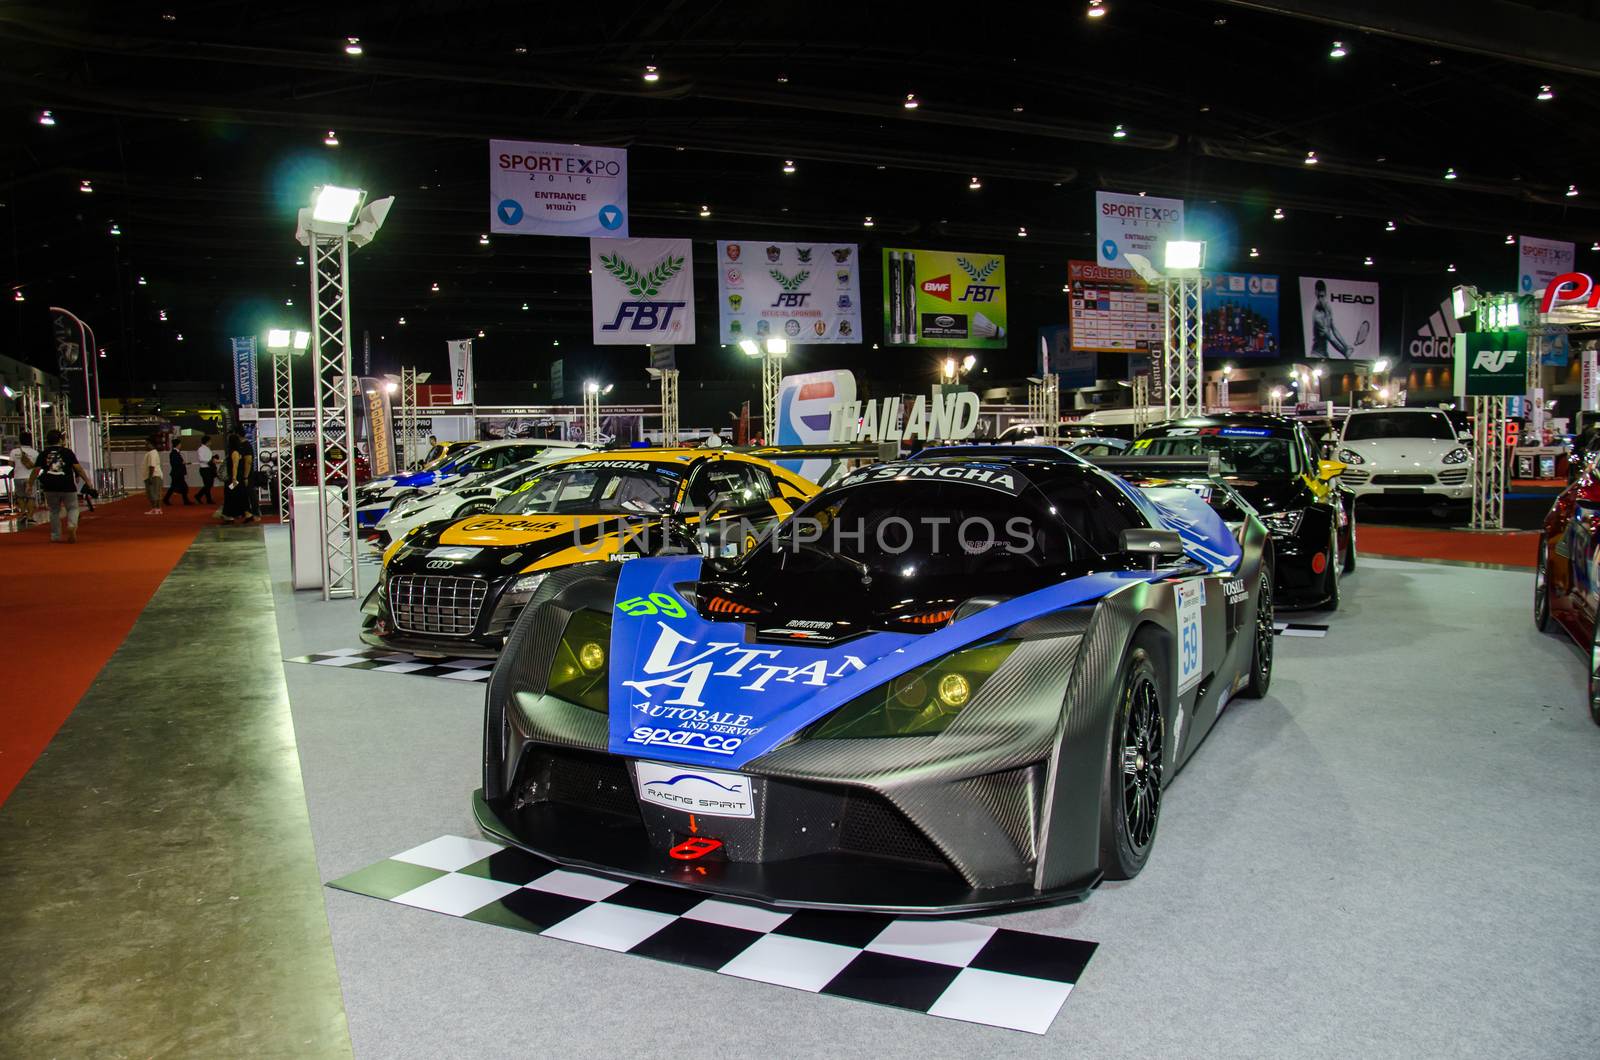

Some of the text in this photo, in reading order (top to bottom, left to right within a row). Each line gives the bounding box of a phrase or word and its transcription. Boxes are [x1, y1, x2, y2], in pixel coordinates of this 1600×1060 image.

[499, 154, 620, 176] SPORT EXPO
[534, 191, 587, 201] ENTRANCE
[1102, 203, 1142, 218] SPORT
[924, 282, 949, 293] BWF
[958, 285, 1000, 302] FBT
[1330, 292, 1375, 304] HEAD
[771, 292, 811, 307] FBT
[601, 301, 686, 330] FBT
[1472, 350, 1518, 372] RUF
[1151, 350, 1163, 399] Dynasty
[828, 391, 980, 442] THAILAND
[1224, 428, 1265, 436] Thailand
[583, 460, 650, 471] SINGHA
[873, 466, 1015, 490] SINGHA
[616, 592, 687, 619] 59
[1183, 621, 1198, 675] 59
[633, 701, 753, 727] AUTOSALE
[679, 721, 709, 730] AND
[633, 727, 742, 750] sparco
